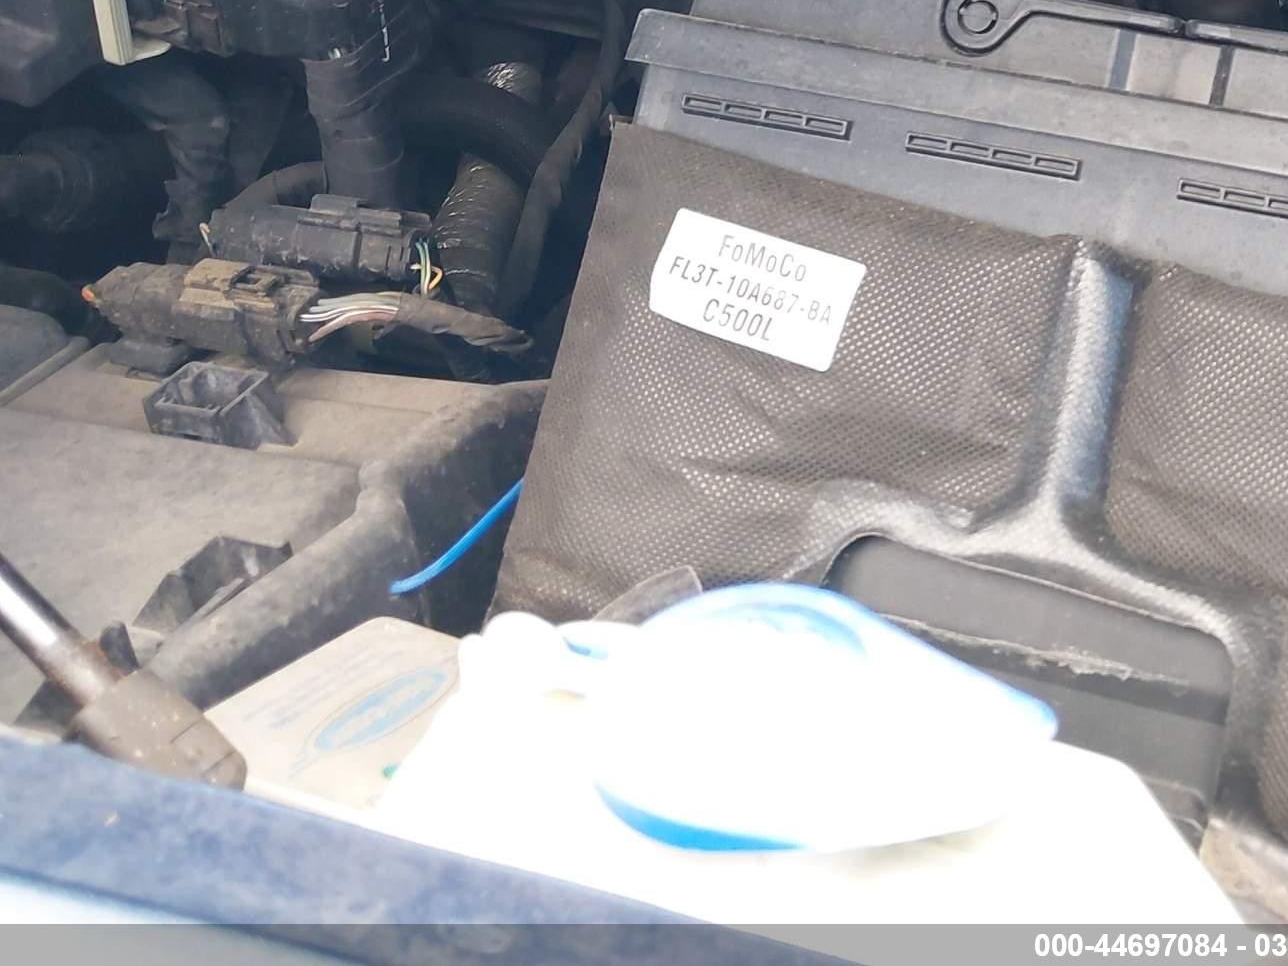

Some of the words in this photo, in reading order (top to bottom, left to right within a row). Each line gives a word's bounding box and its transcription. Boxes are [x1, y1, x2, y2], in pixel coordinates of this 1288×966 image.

[718, 234, 807, 282] FoMoCo
[669, 256, 832, 326] FL3T-10A687-BA
[703, 298, 776, 341] C500L
